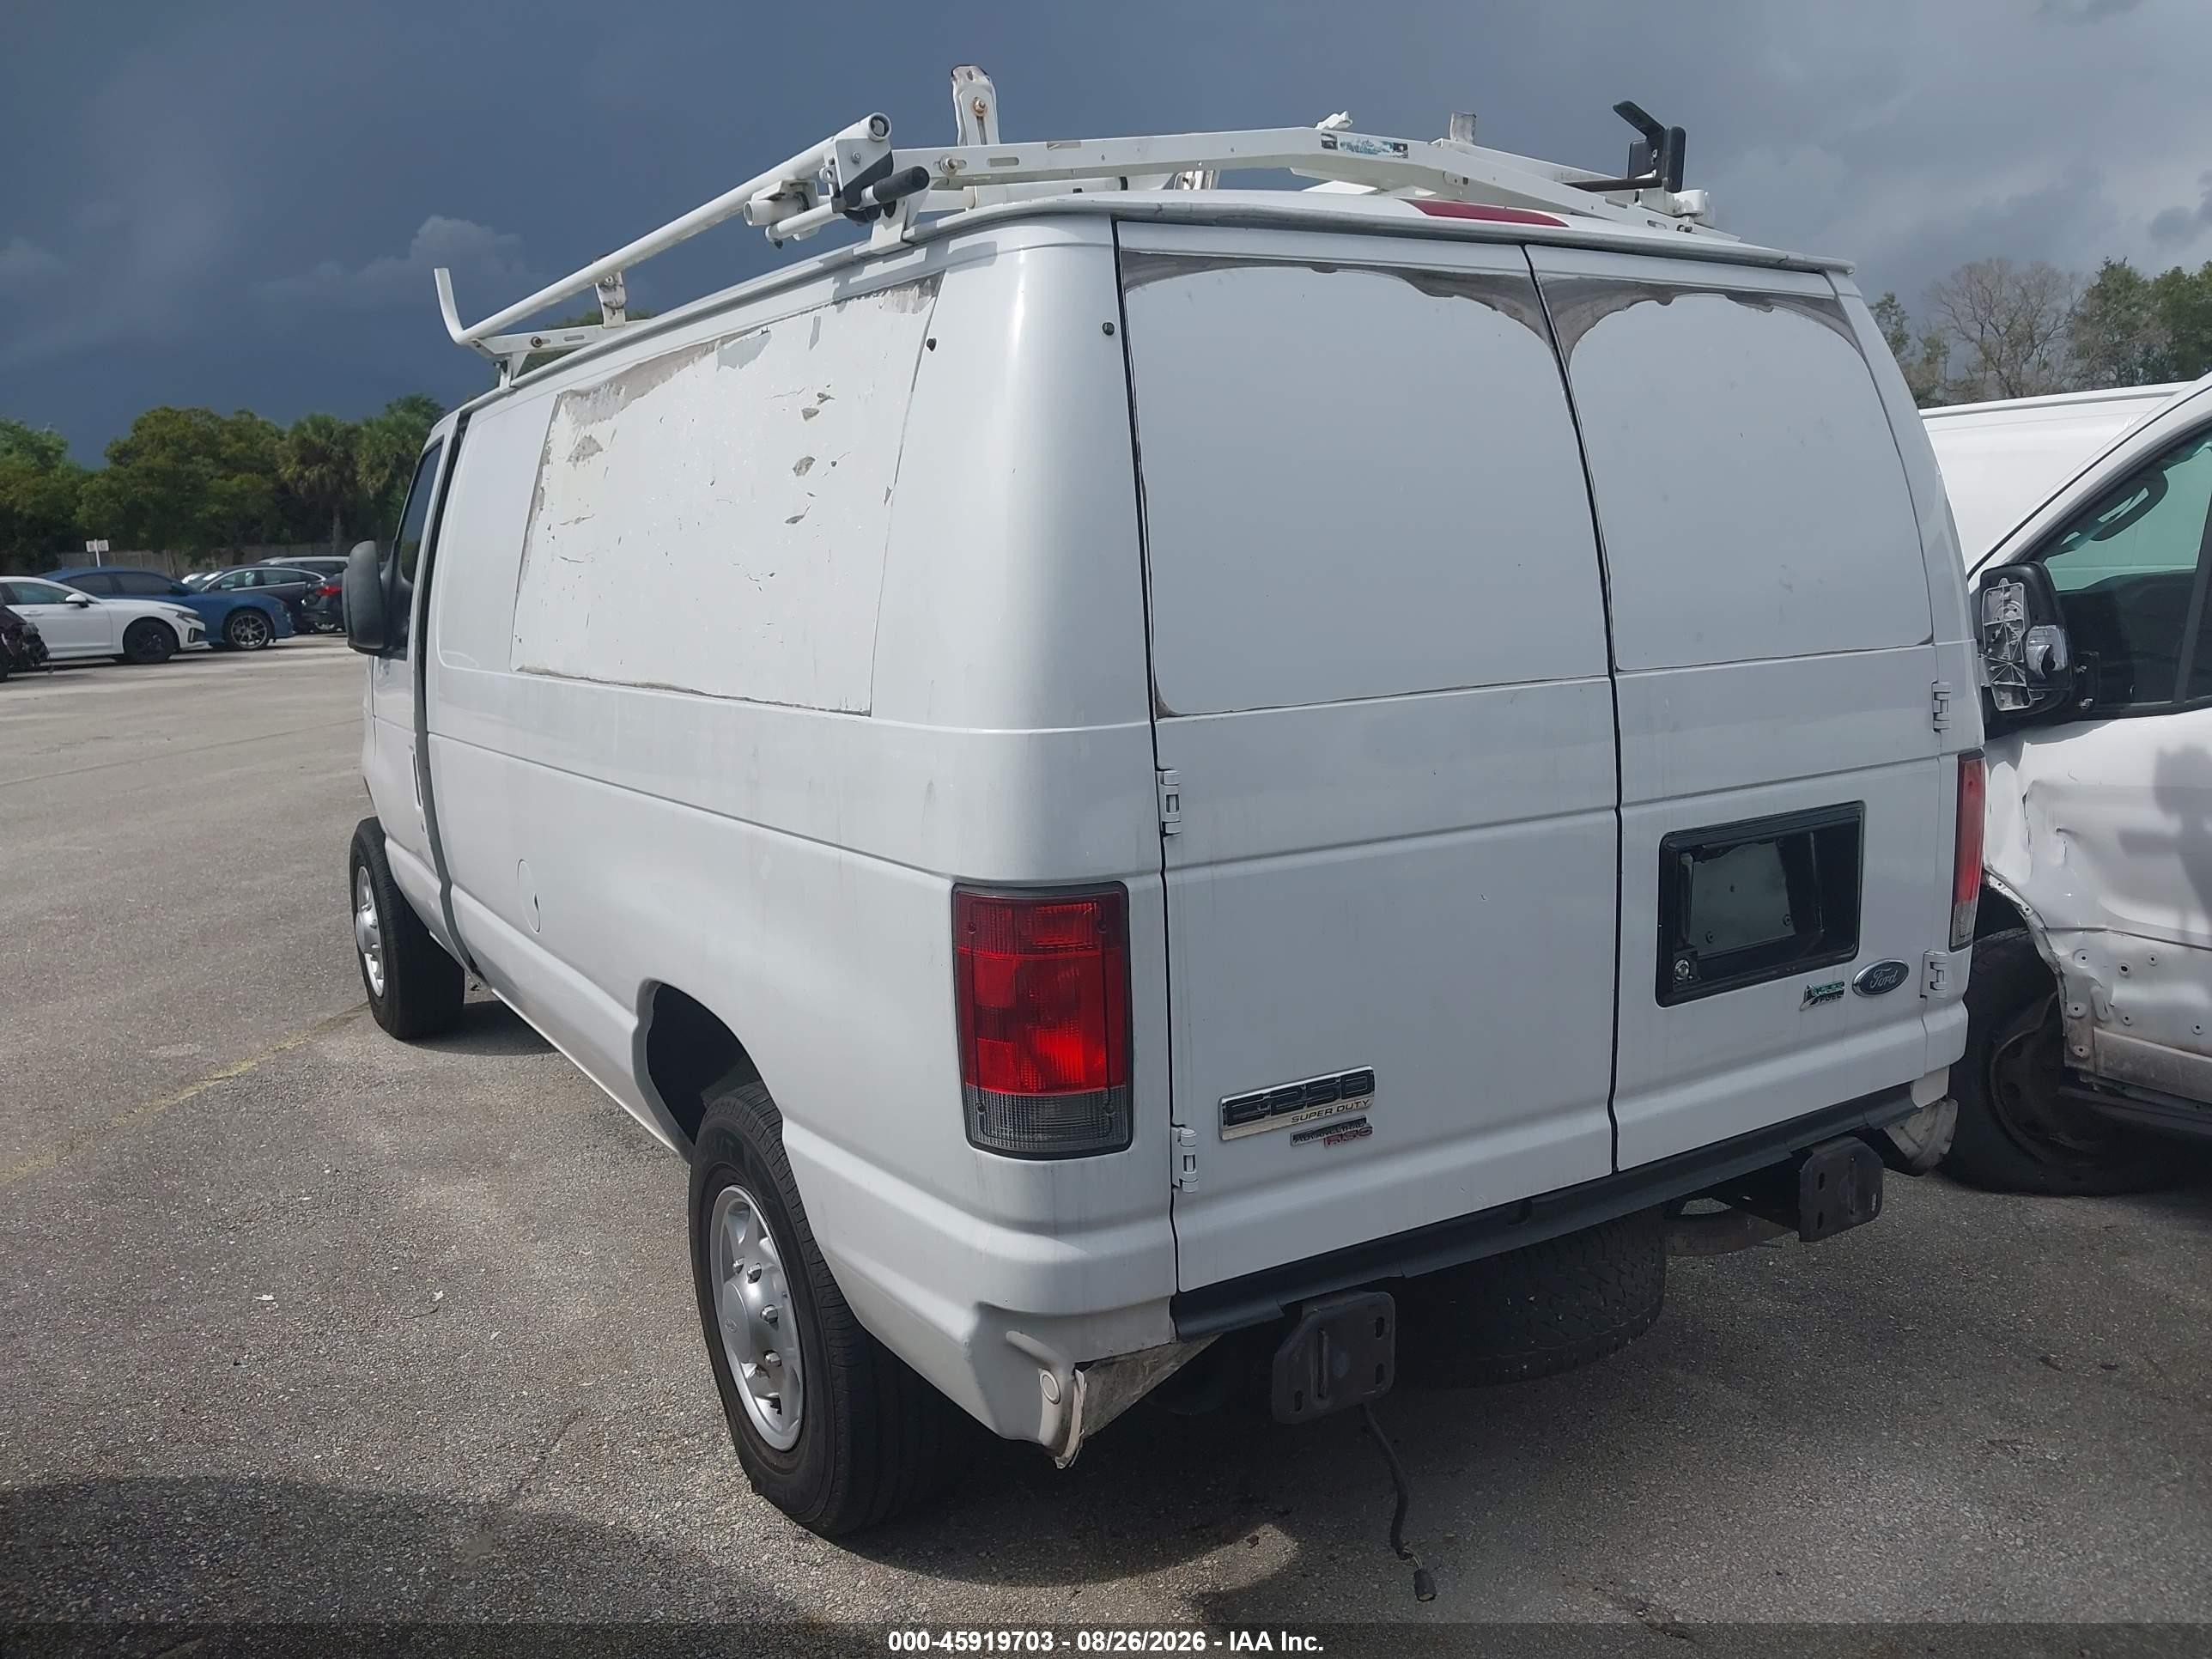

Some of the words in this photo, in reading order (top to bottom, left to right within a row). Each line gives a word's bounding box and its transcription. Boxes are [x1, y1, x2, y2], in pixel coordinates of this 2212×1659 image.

[1870, 967, 1898, 988] Ford
[1291, 1109, 1333, 1123] SUPER
[1337, 1099, 1370, 1112] DUTY
